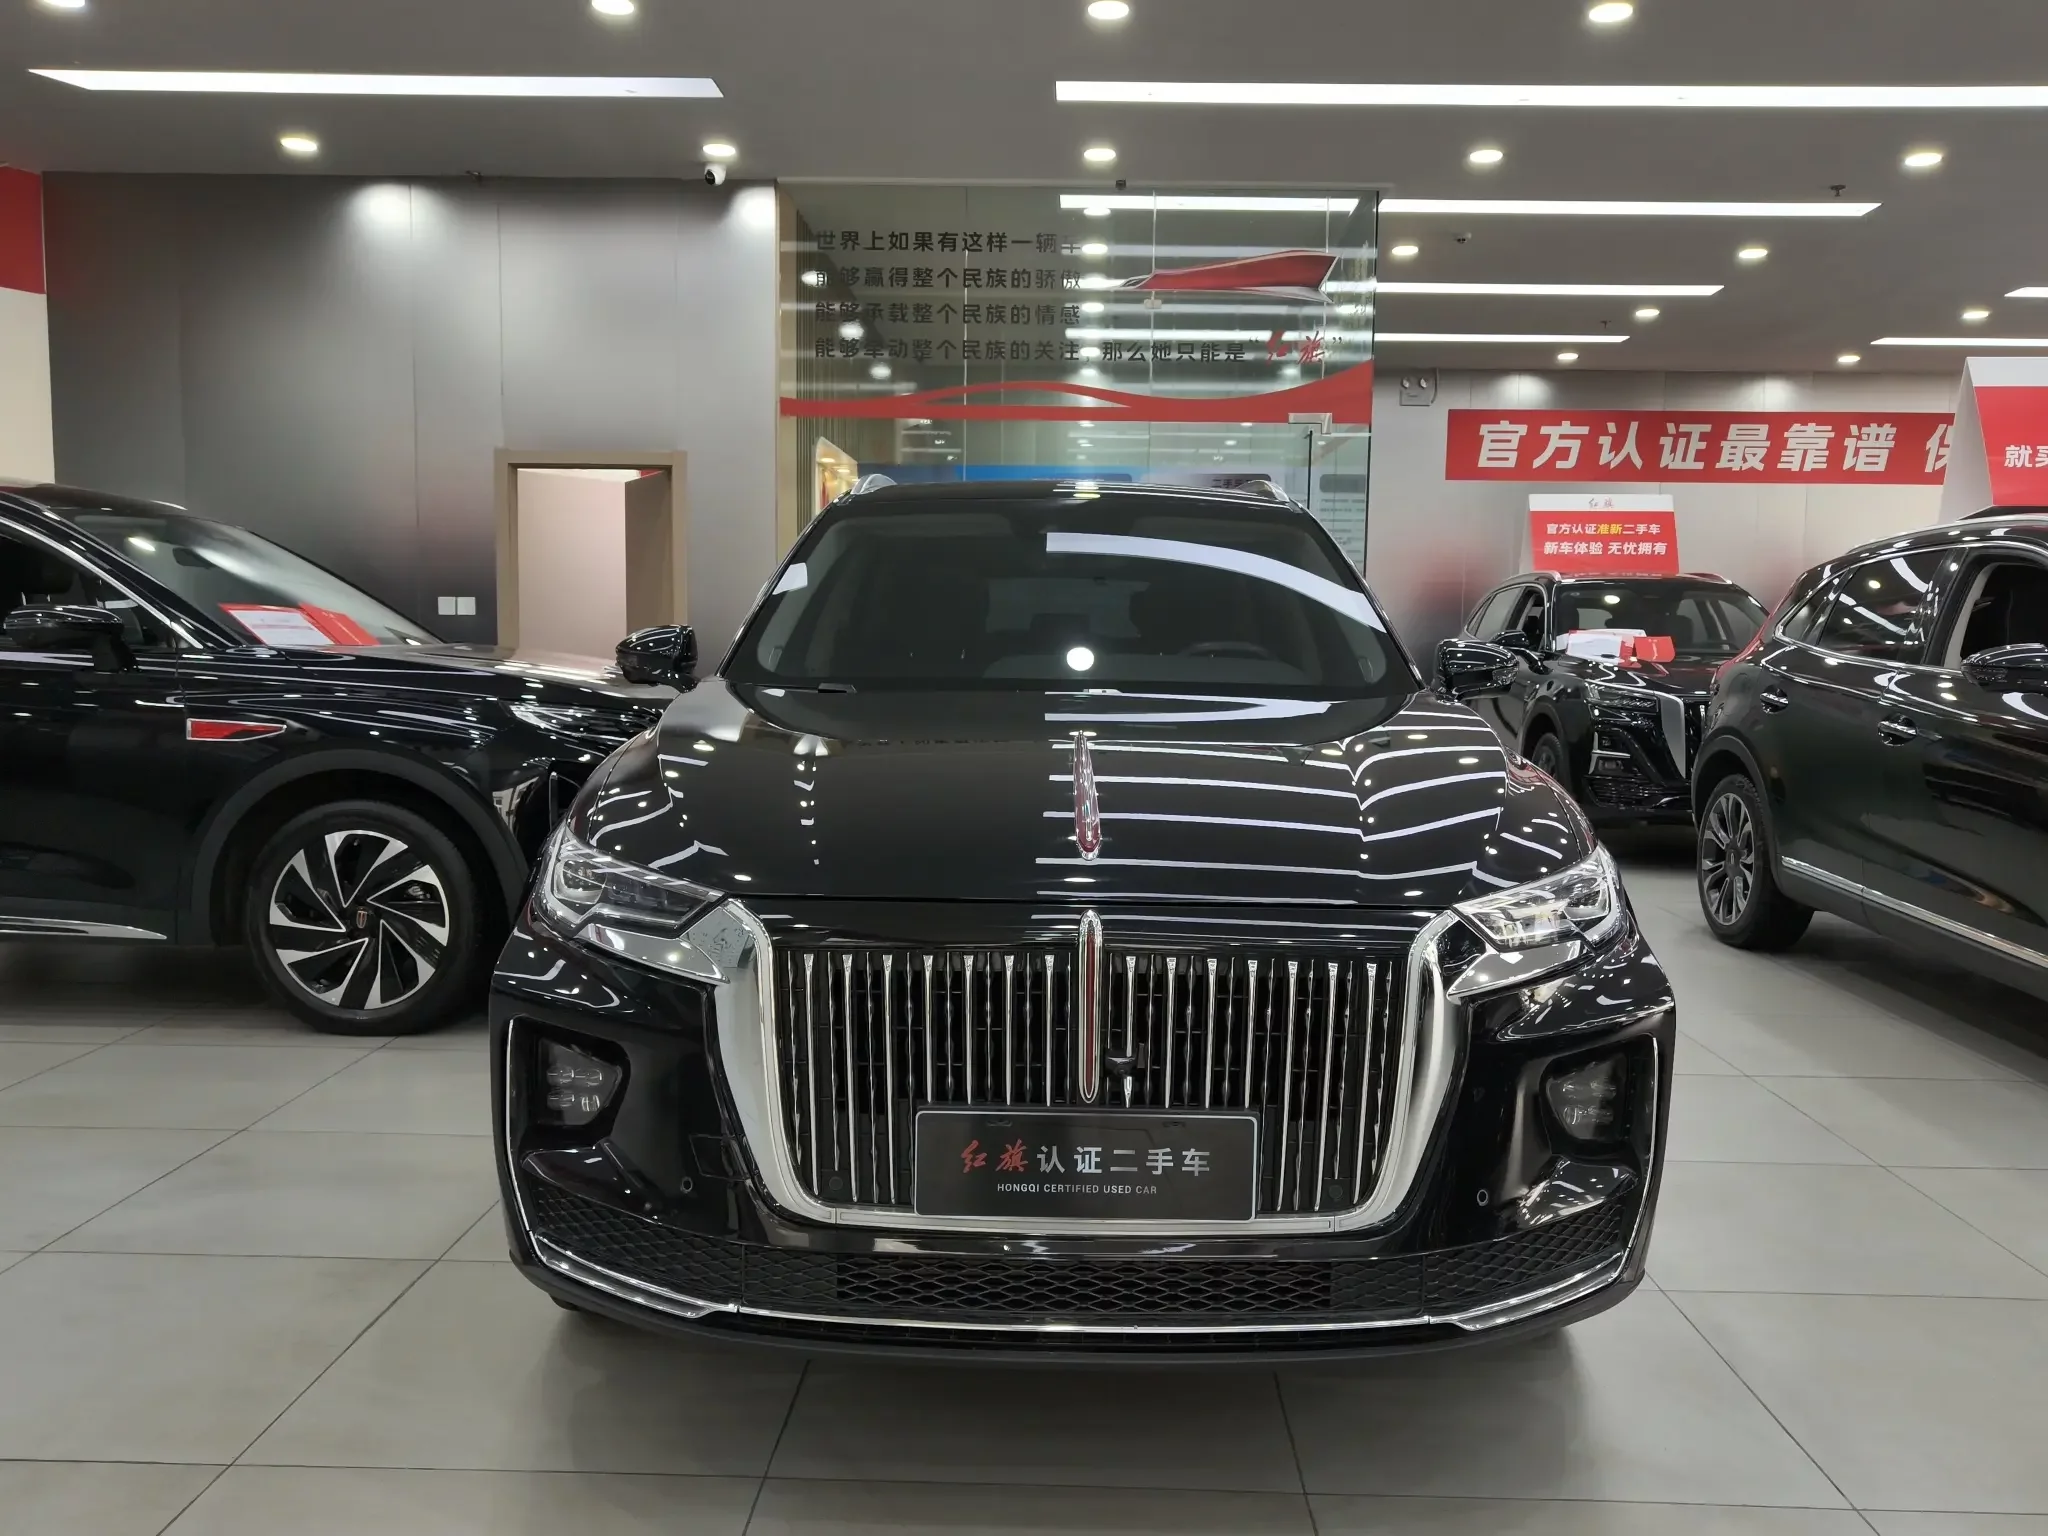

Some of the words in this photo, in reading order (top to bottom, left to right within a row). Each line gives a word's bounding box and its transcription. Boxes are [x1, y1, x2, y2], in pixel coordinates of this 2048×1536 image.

[1477, 420, 1898, 473] 官方认证最靠谱
[1546, 523, 1661, 535] 官方认证准新二手车
[1543, 541, 1604, 555] 新车体验
[1607, 542, 1668, 556] 无忧拥有
[997, 1183, 1040, 1193] HONGQI
[1043, 1184, 1100, 1194] CERTIFIED
[1103, 1185, 1132, 1194] USED
[1135, 1186, 1157, 1195] CAR
